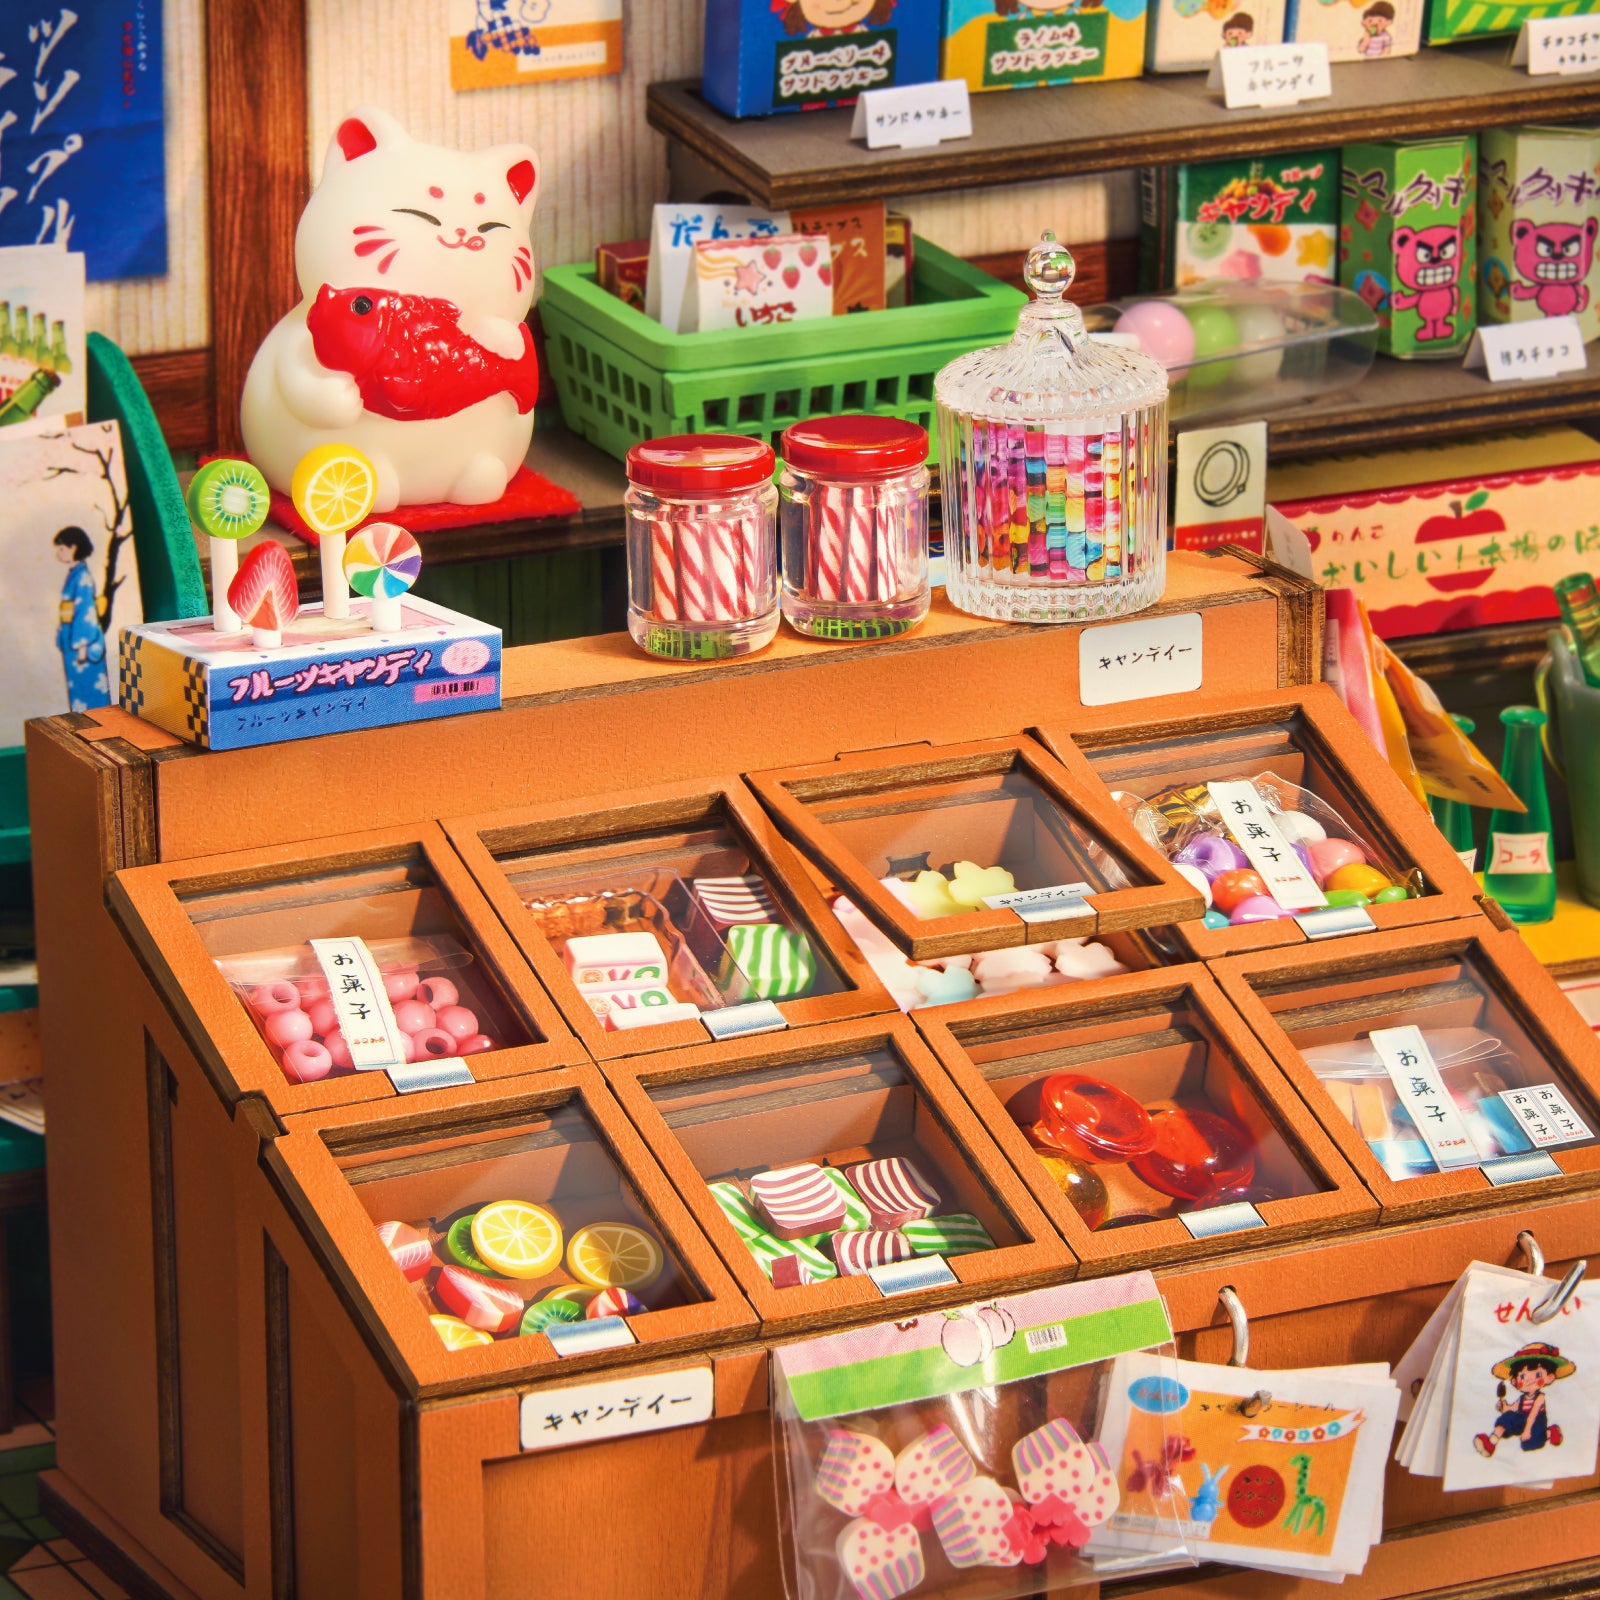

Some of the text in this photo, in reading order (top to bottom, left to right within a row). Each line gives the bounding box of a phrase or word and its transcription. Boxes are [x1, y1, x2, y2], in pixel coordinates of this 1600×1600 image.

[735, 302, 797, 328] いちご
[229, 648, 432, 702] フルーツキャンディ
[1500, 848, 1541, 865] コーラ
[1493, 1294, 1582, 1325] せんい
